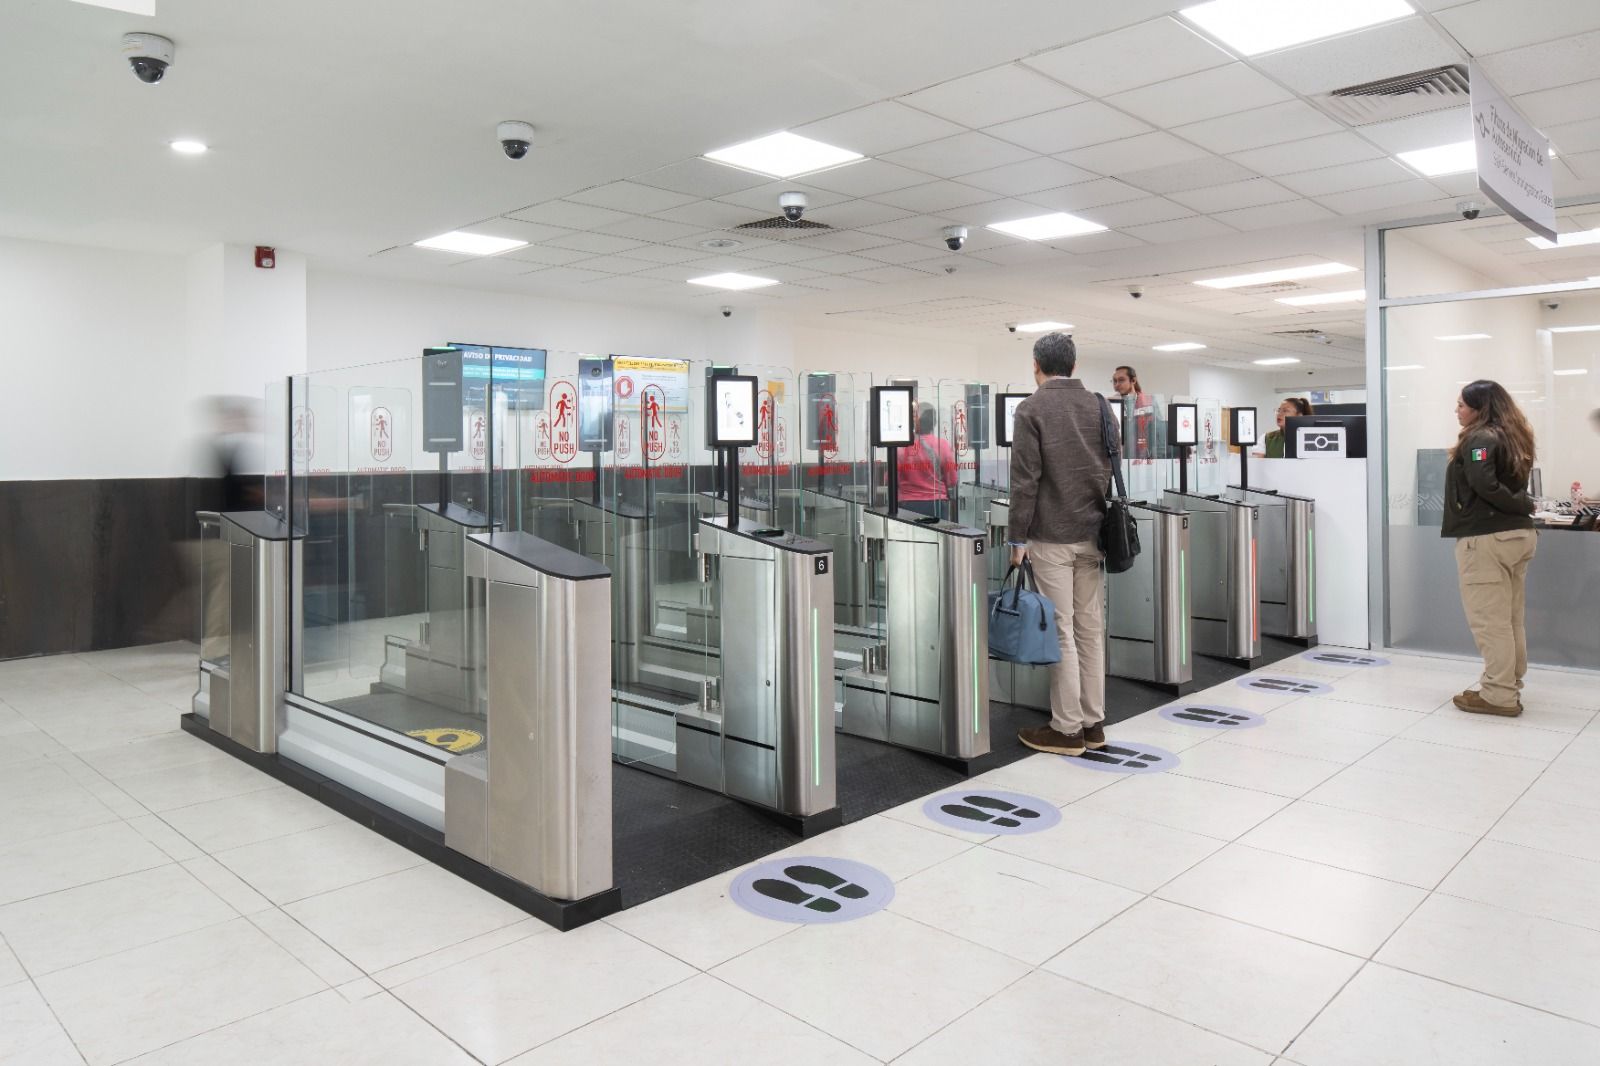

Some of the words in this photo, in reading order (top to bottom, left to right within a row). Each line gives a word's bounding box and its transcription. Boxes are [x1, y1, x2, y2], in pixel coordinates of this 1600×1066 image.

[463, 351, 484, 359] AVISO
[558, 431, 570, 442] NO
[648, 430, 659, 441] NO
[377, 440, 386, 448] NO
[553, 443, 575, 454] PUSH
[373, 448, 390, 456] PUSH
[976, 542, 982, 552] 5
[818, 560, 825, 571] 6
